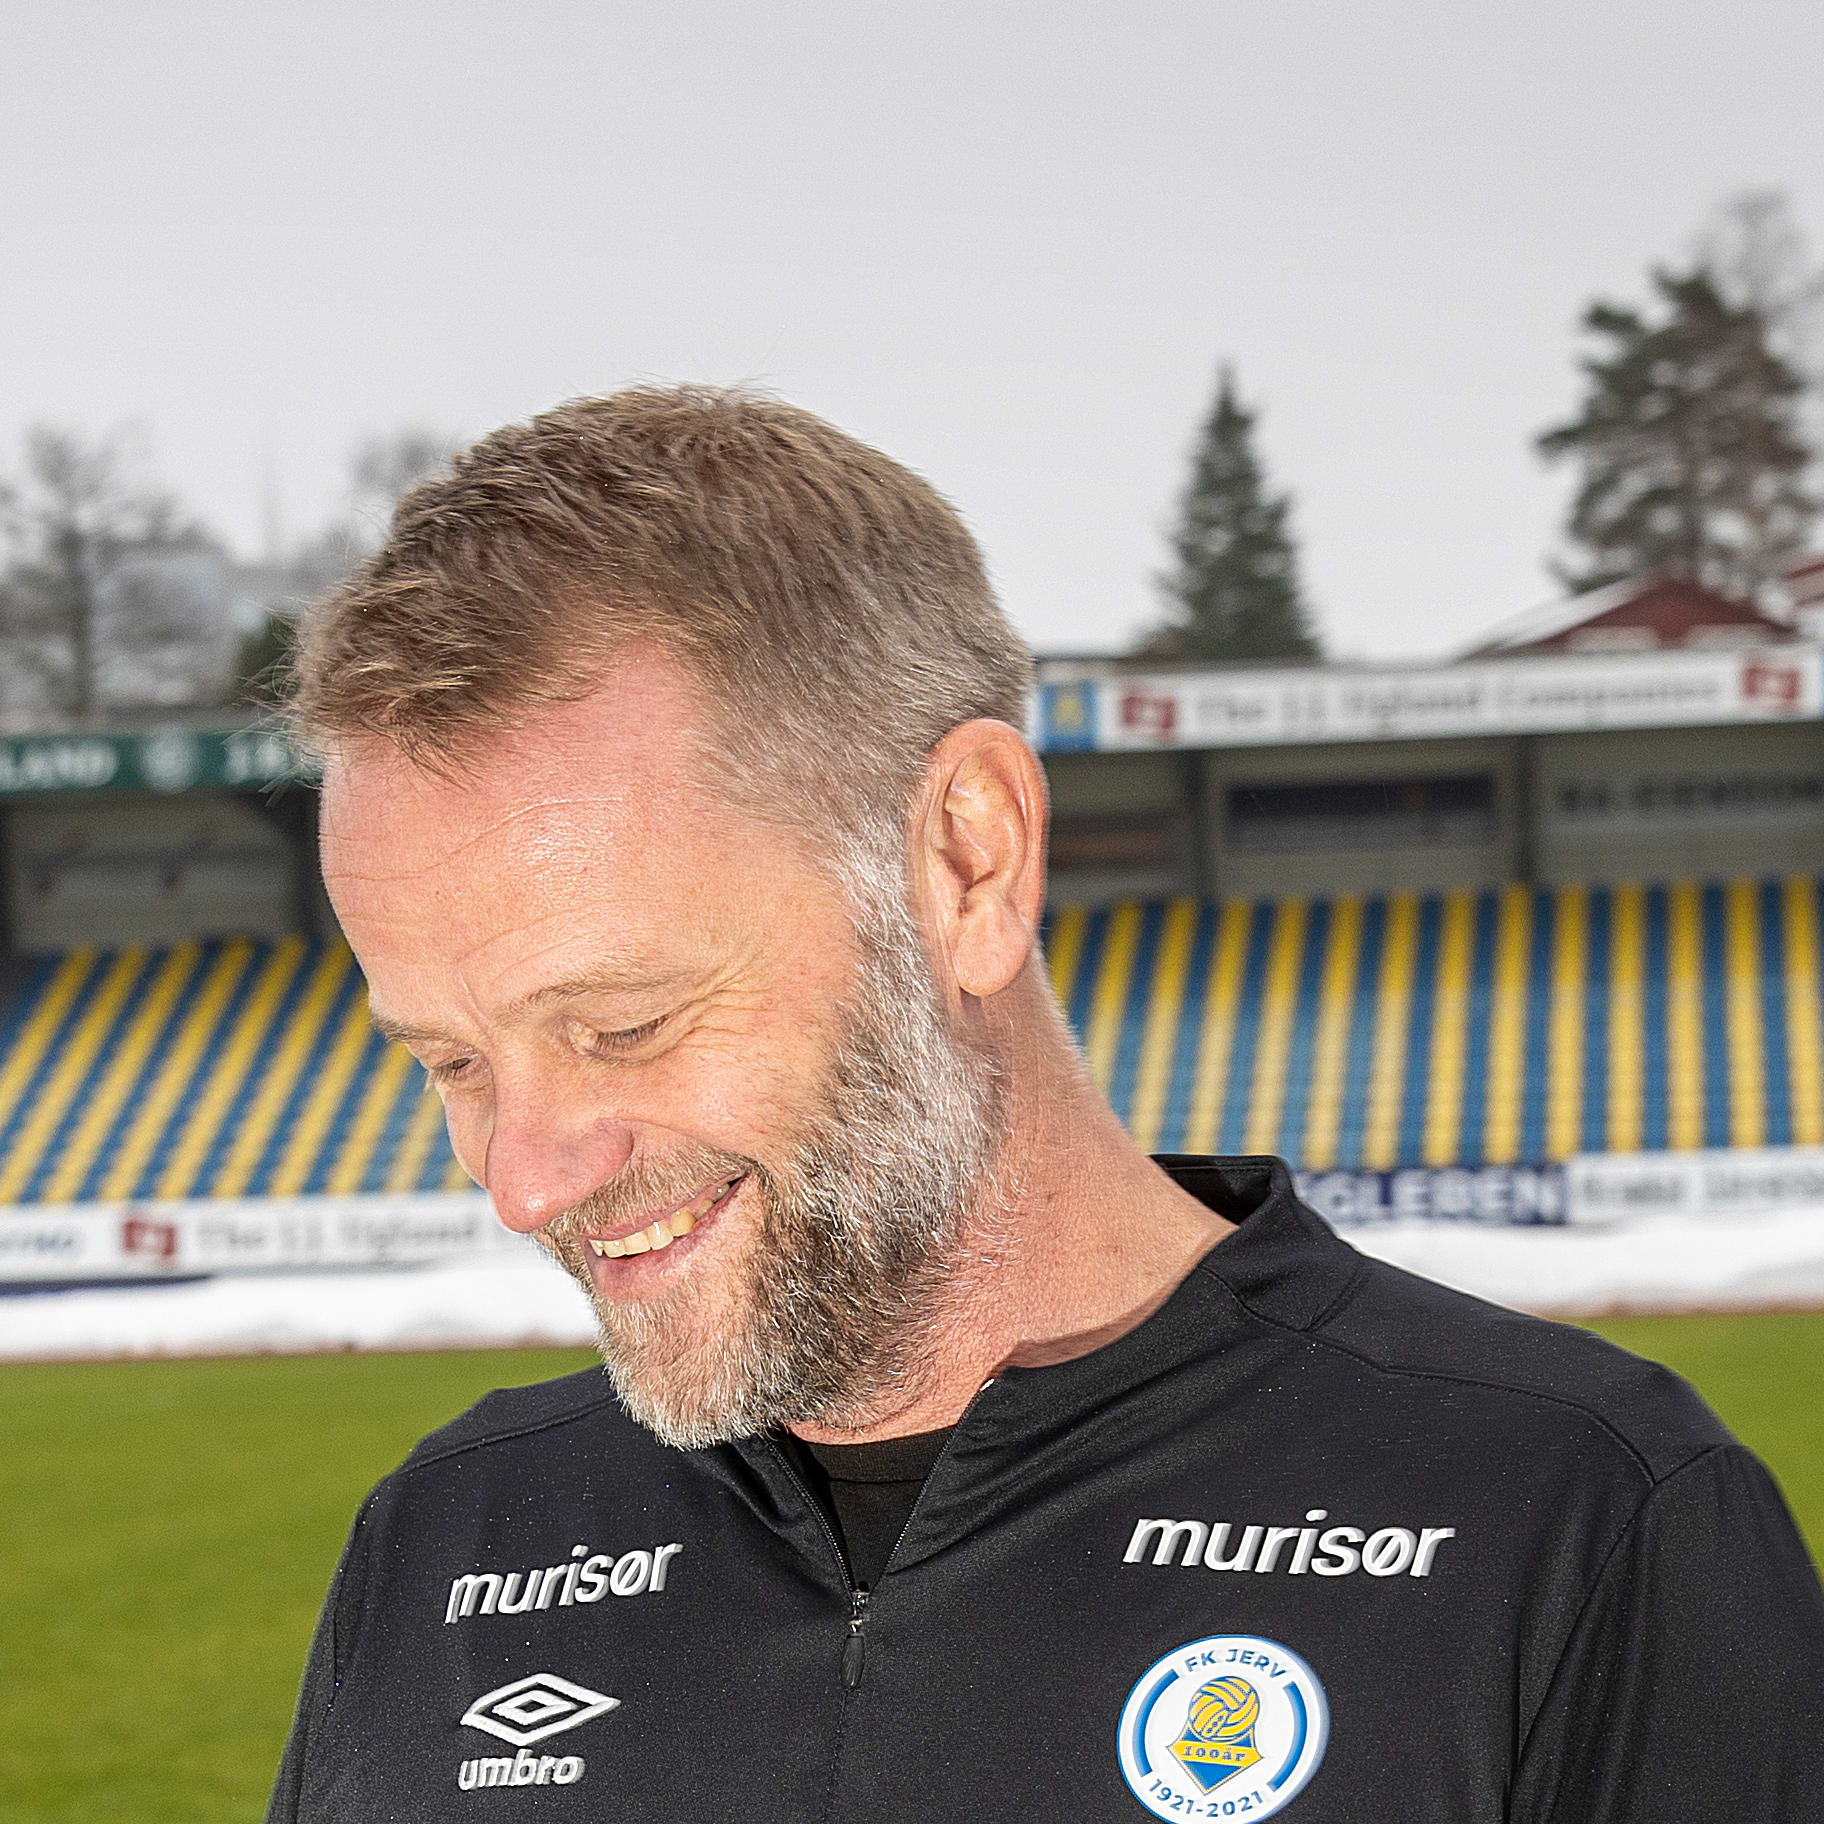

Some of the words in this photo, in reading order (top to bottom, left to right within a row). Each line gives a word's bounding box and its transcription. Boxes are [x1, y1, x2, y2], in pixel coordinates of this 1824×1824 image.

[1123, 1509, 1455, 1577] murisør
[445, 1543, 683, 1624] murisør
[1184, 1650, 1217, 1673] FK
[1225, 1648, 1288, 1679] JERV
[457, 1748, 585, 1791] umbro
[1148, 1778, 1264, 1818] 1921-2021
